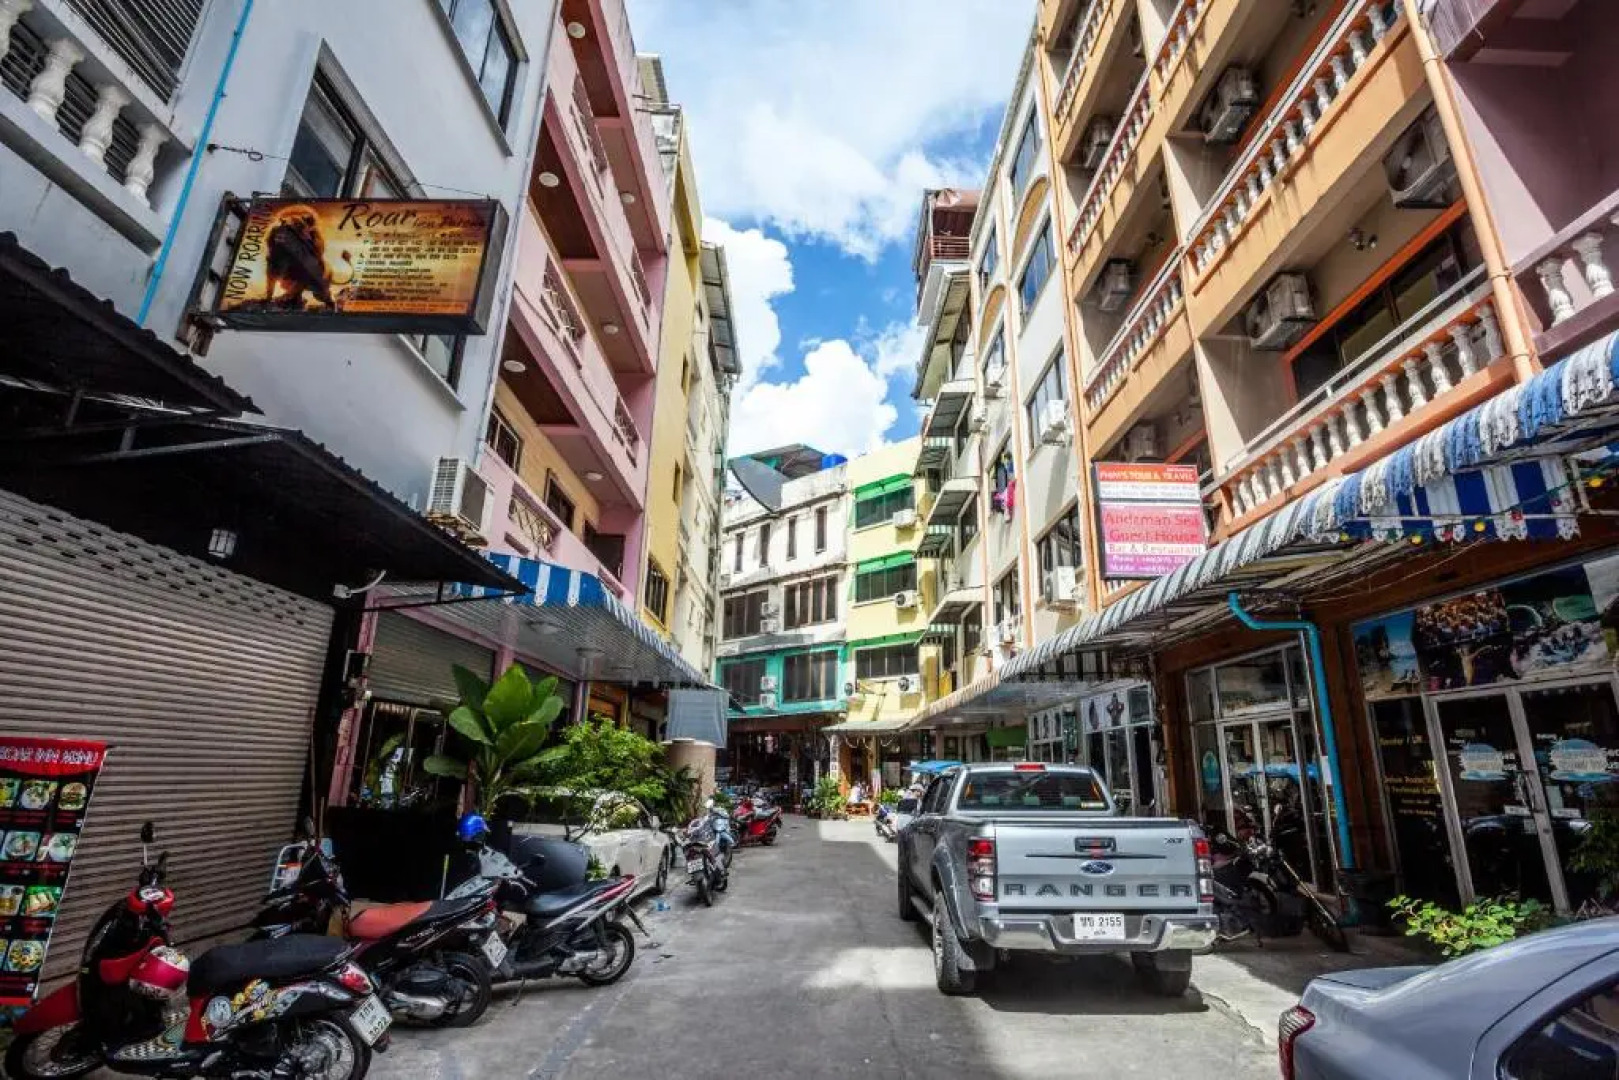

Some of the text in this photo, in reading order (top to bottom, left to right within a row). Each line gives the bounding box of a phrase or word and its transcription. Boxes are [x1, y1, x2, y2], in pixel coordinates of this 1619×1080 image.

[338, 203, 417, 230] Roar
[225, 265, 253, 300] NOW
[1004, 883, 1193, 898] RANGER
[1098, 916, 1122, 928] 2155
